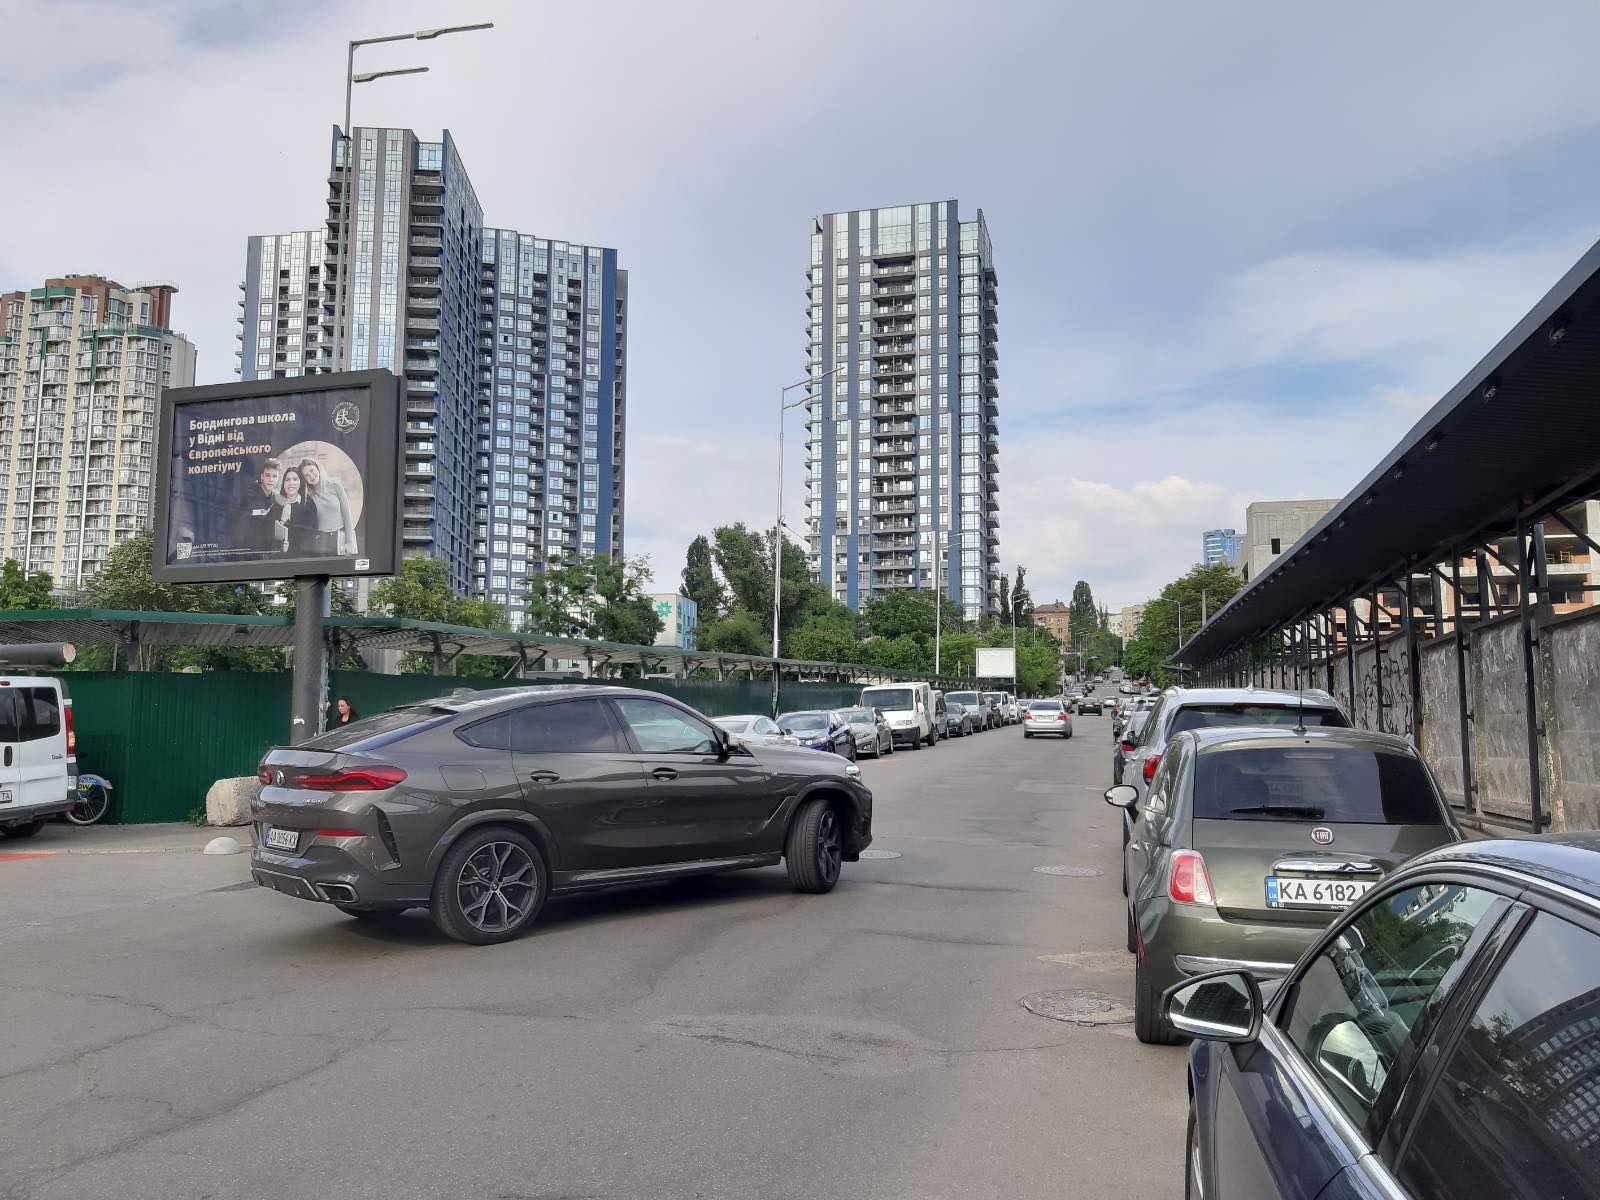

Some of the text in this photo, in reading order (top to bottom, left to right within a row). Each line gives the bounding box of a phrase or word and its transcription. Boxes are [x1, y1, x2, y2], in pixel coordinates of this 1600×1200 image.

[189, 412, 296, 432] Бордингова школа
[189, 429, 245, 448] у Відні від
[188, 444, 272, 461] Європейського
[188, 460, 243, 475] колегіуму
[1316, 831, 1329, 840] FIAT
[1279, 882, 1308, 900] KA
[1313, 883, 1357, 902] 6182
